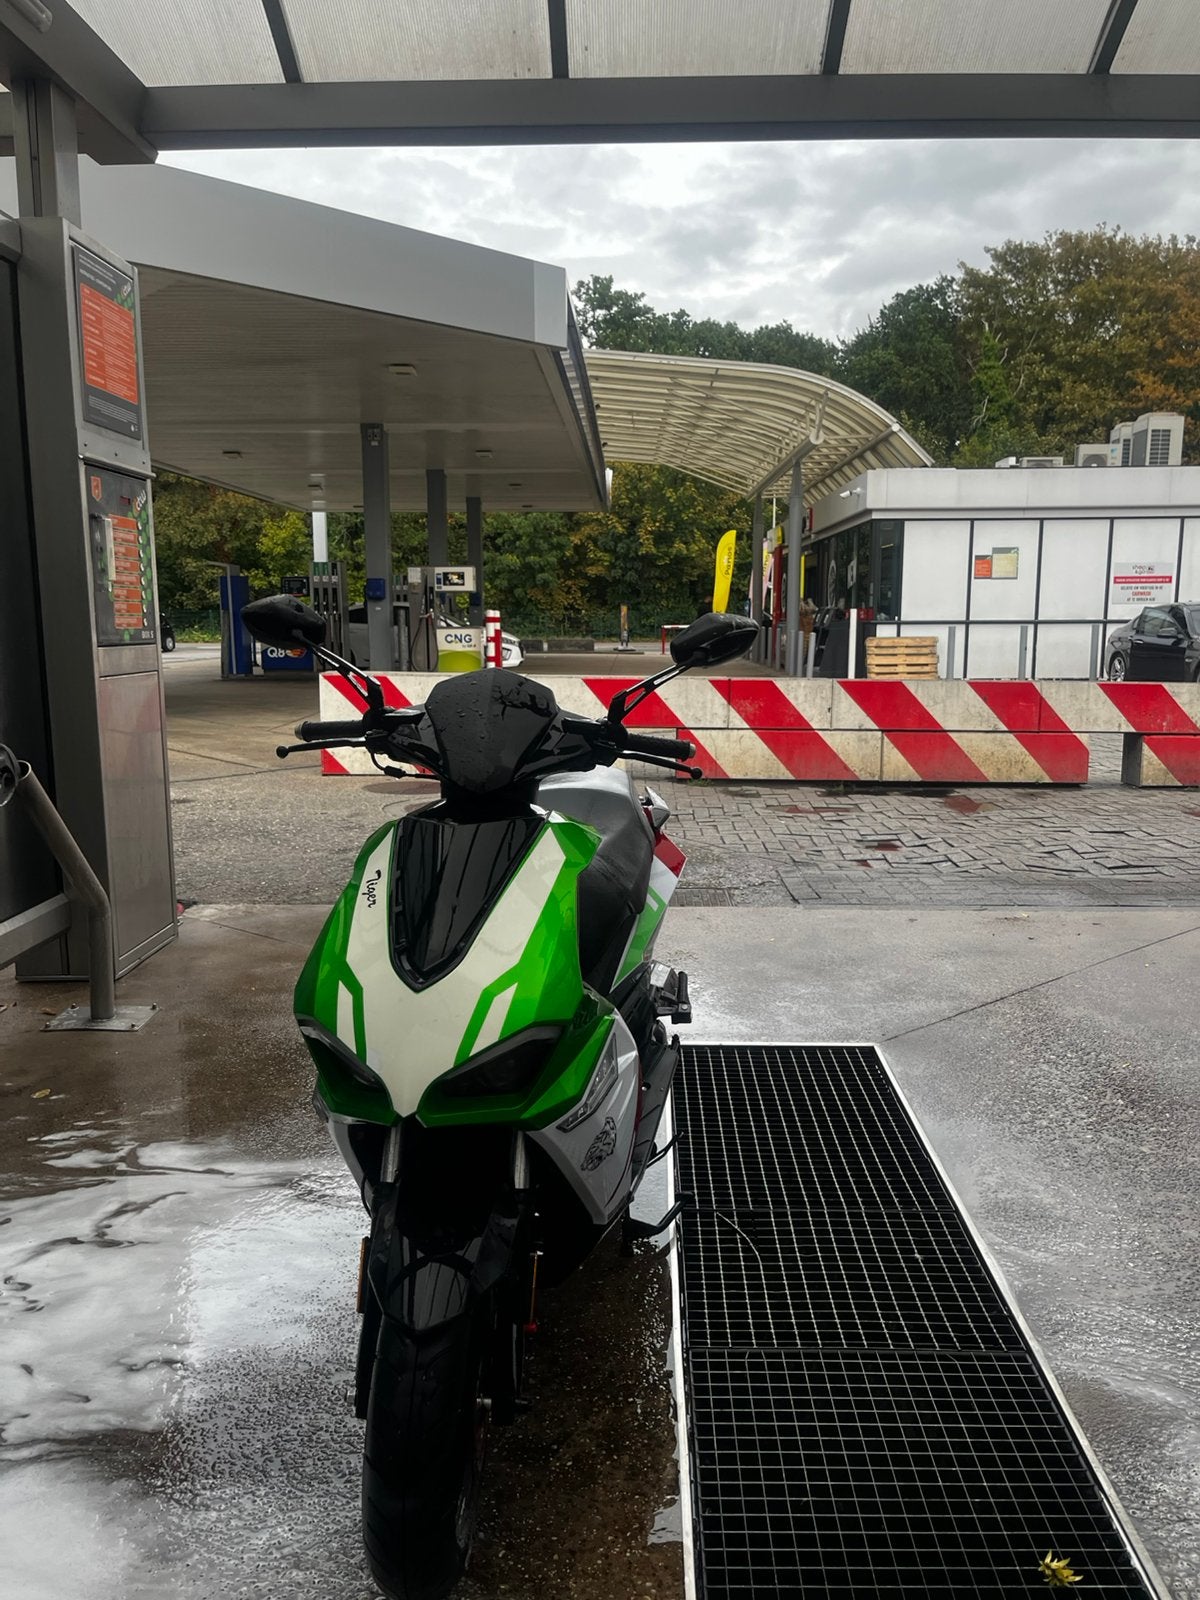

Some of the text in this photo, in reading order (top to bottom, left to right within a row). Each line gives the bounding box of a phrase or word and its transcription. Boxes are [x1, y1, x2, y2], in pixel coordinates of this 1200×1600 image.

[724, 546, 733, 576] Panos
[444, 633, 473, 644] CNG
[267, 646, 285, 658] Q8
[361, 869, 382, 909] Tiger
